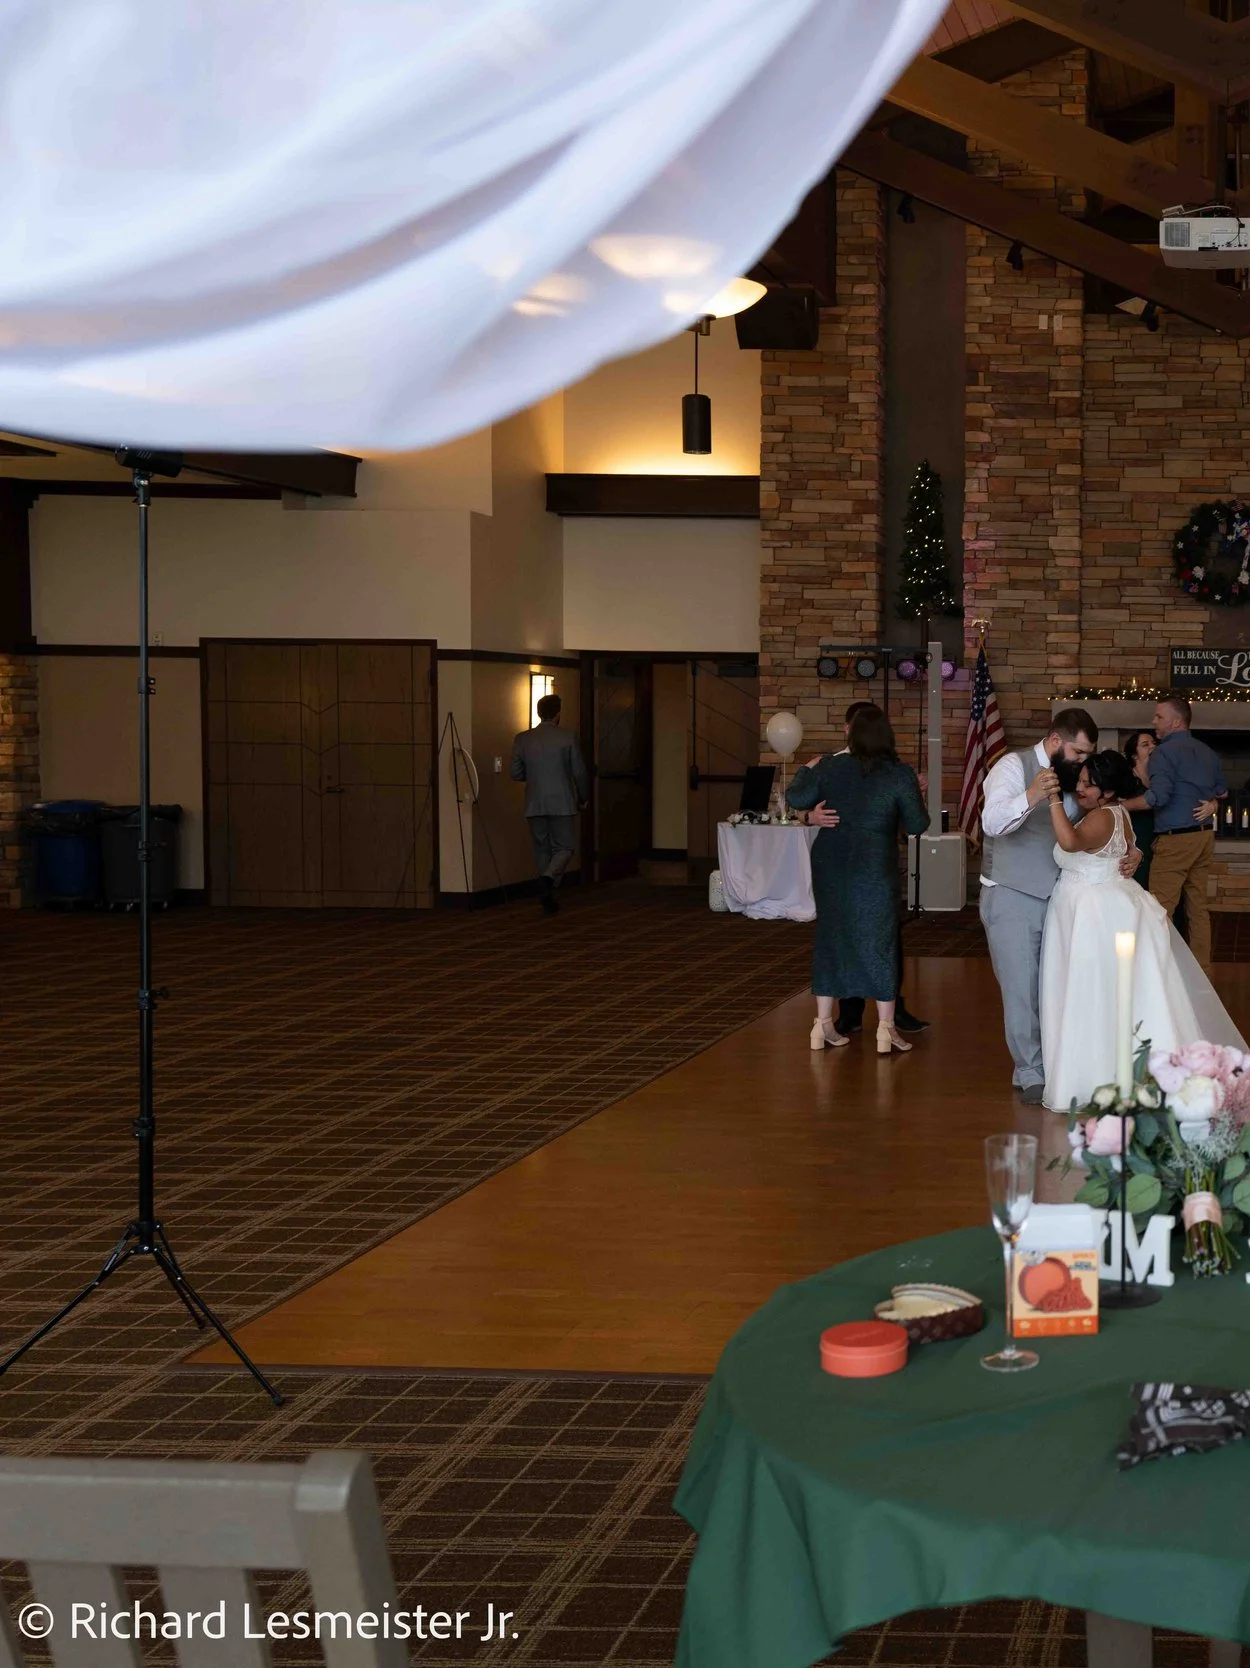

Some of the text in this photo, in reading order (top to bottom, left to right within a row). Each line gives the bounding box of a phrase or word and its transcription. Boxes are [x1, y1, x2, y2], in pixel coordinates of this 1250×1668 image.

[1172, 651, 1186, 660] ALL
[1187, 651, 1221, 661] BECAUSE
[1173, 665, 1201, 675] FELL
[1203, 665, 1217, 675] IN
